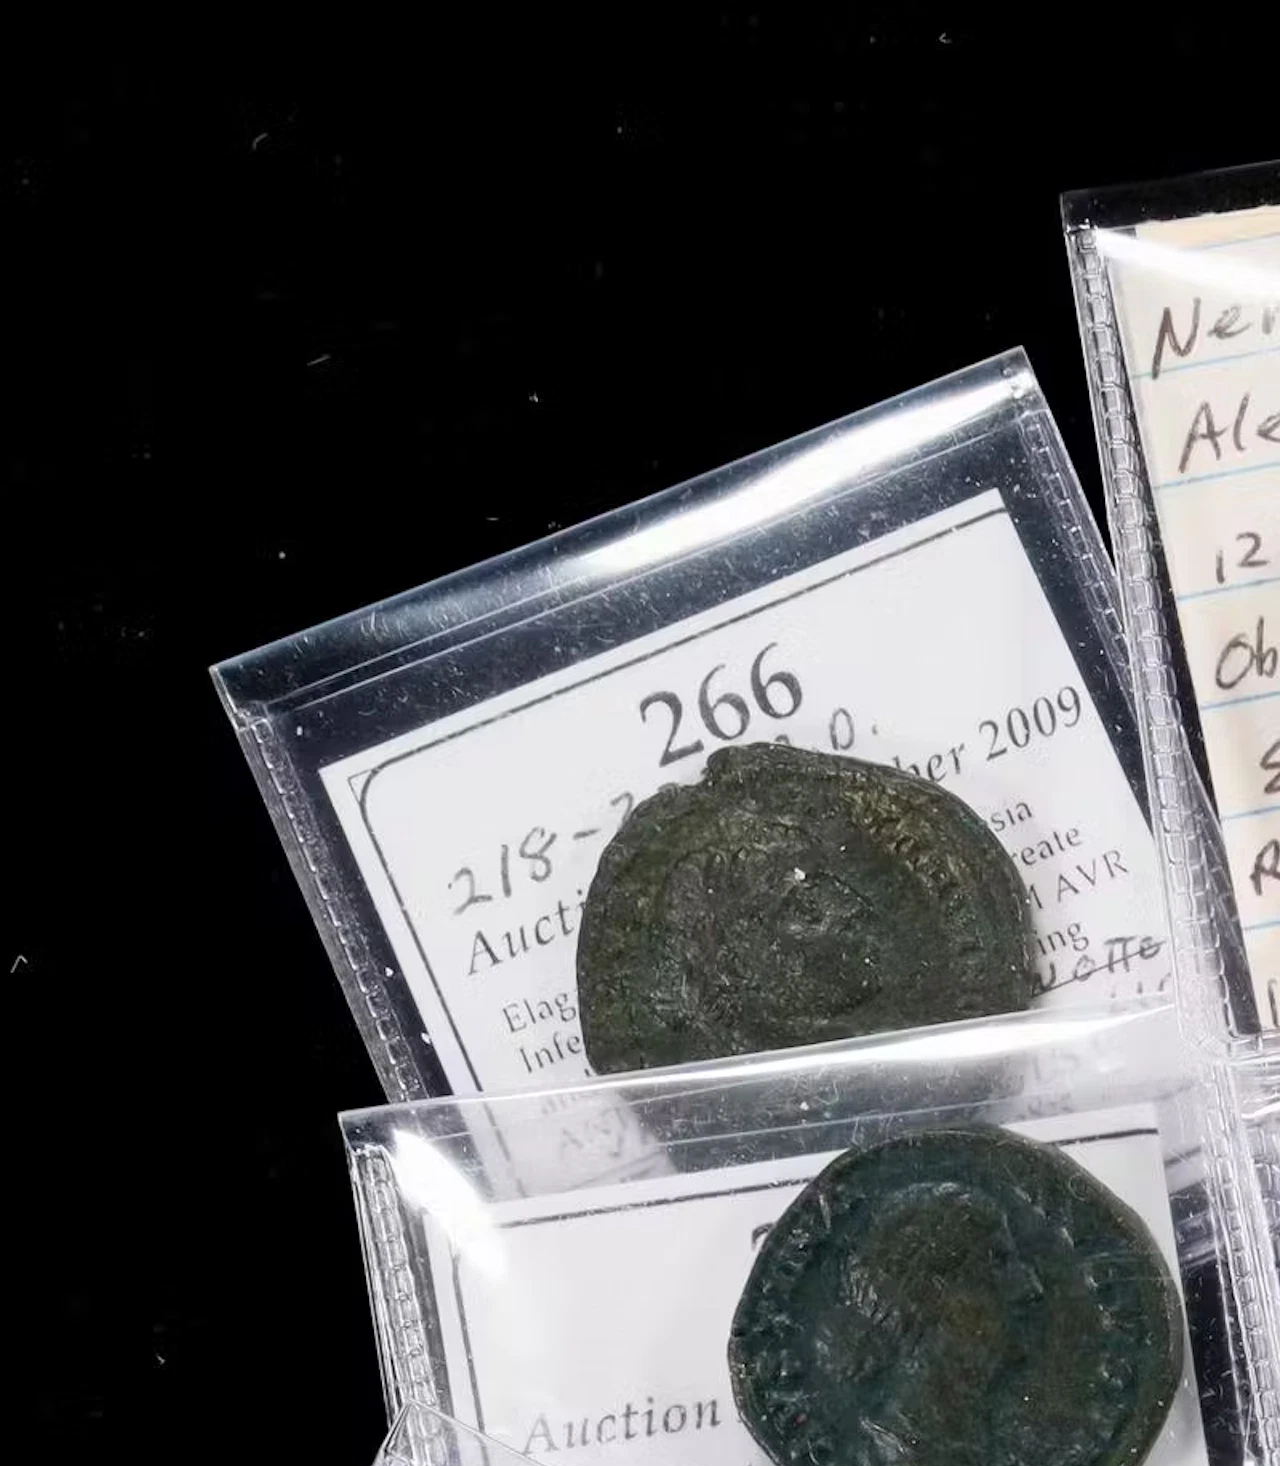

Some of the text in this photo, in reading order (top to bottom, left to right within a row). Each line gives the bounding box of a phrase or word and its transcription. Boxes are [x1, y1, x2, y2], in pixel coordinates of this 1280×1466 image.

[638, 640, 805, 769] 266
[977, 683, 1083, 765] 2009
[519, 1398, 722, 1459] Auction
